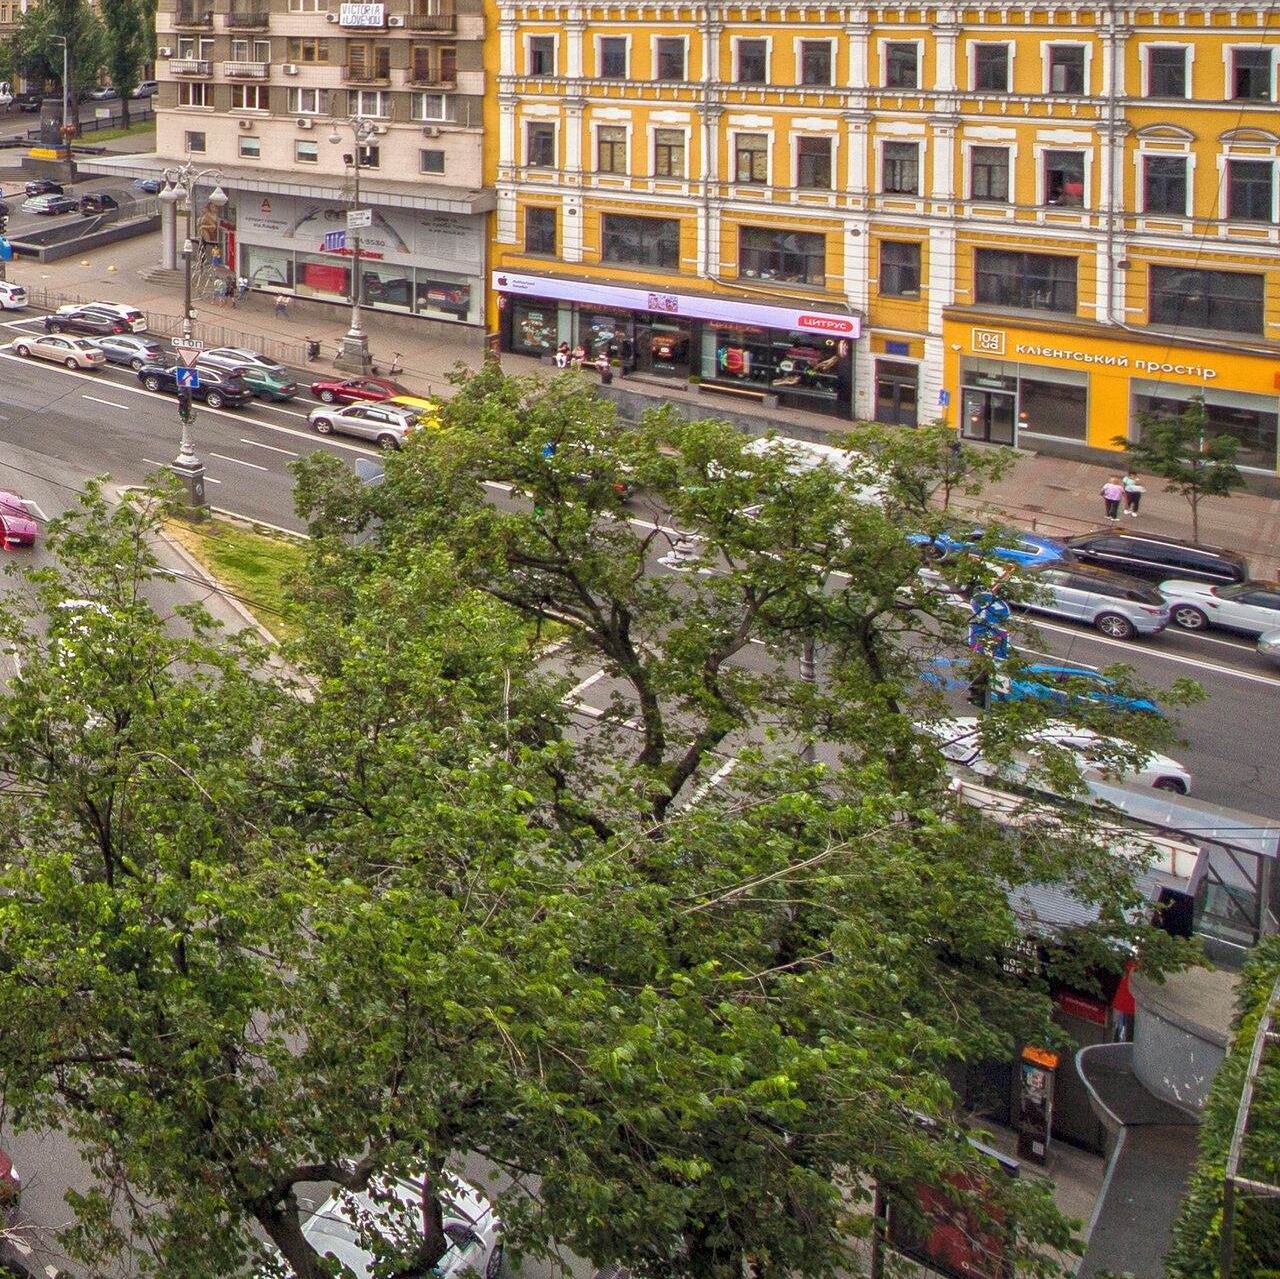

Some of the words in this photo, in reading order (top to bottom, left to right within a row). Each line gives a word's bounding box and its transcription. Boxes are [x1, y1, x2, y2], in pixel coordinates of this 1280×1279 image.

[342, 4, 381, 15] VICTORIA
[803, 318, 847, 330] ЦИТРУС
[977, 332, 999, 343] 104
[1015, 344, 1128, 367] клієнтський
[1135, 360, 1216, 380] простір
